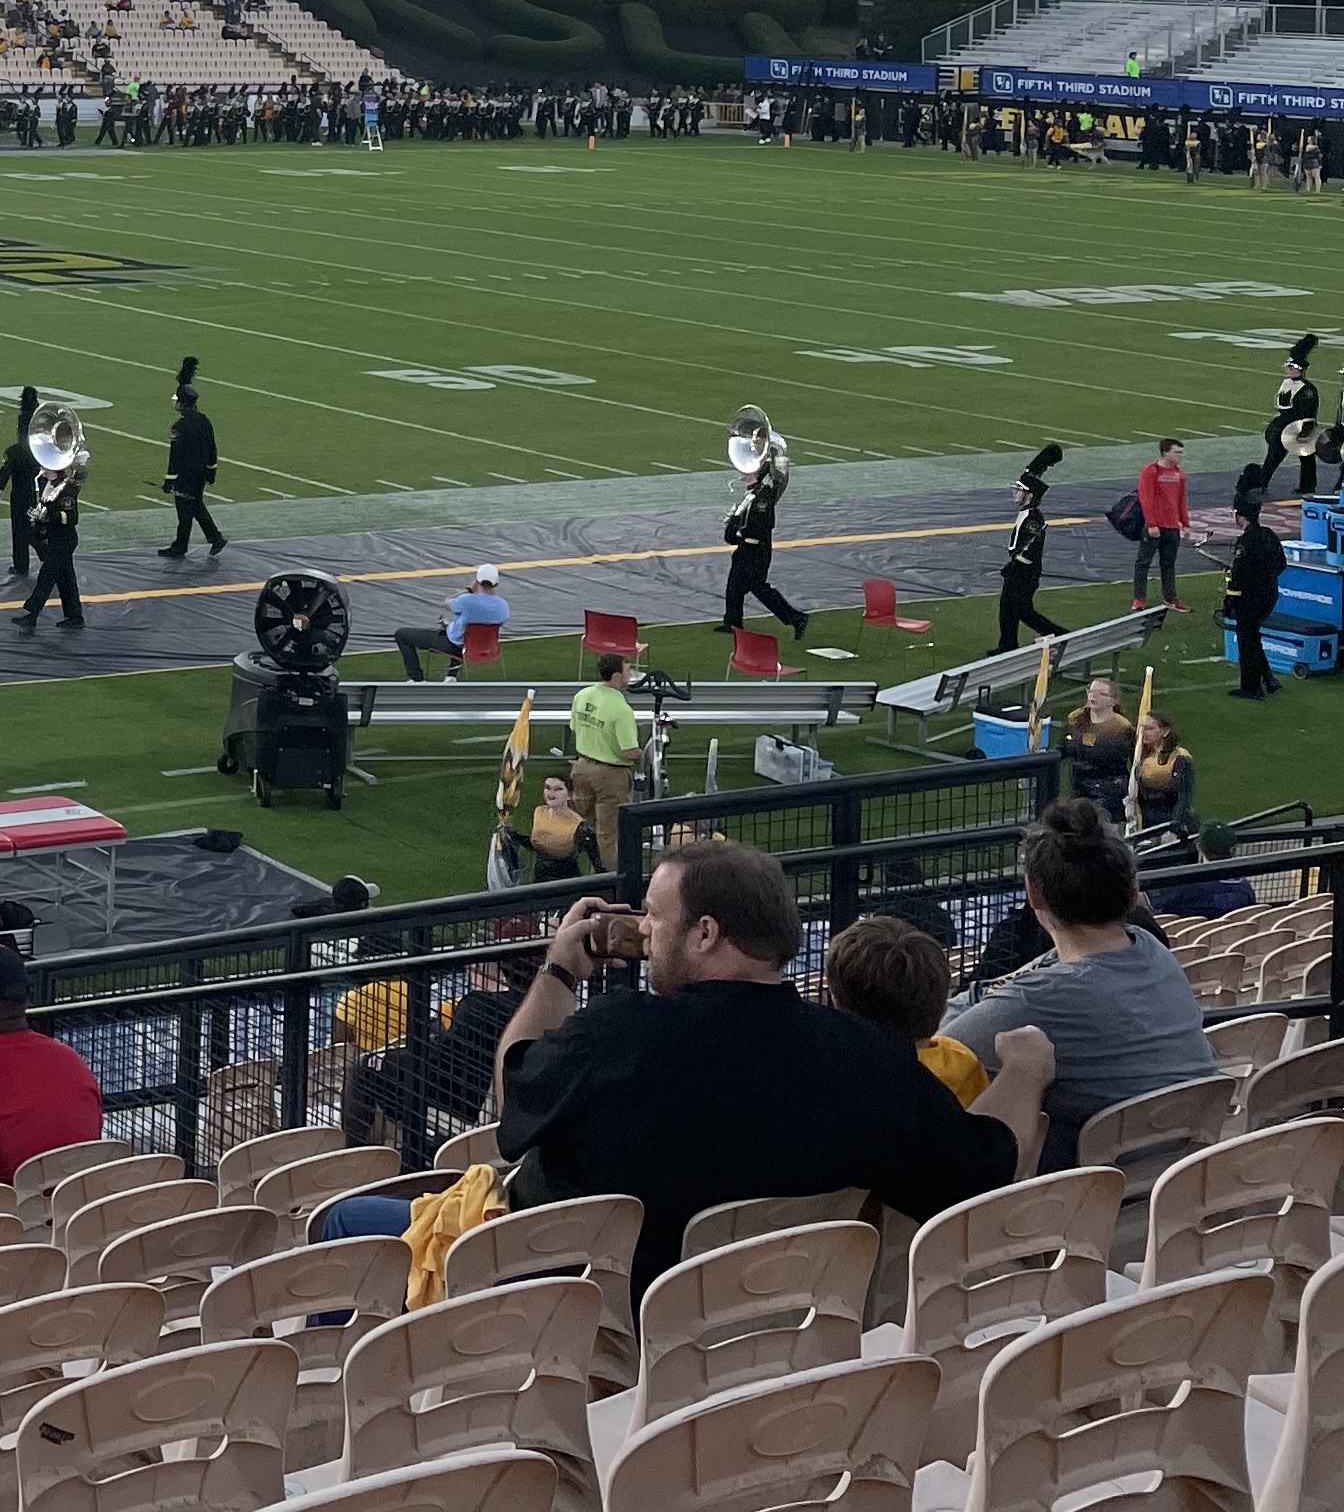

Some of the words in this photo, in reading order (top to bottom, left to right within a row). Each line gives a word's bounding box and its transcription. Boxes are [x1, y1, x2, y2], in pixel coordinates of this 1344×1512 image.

[825, 67, 859, 79] THIRD
[862, 69, 908, 81] STADIUM
[1017, 79, 1053, 92] FIFTH
[1057, 81, 1095, 93] THIRD
[1098, 84, 1152, 97] STADIUM
[1238, 92, 1278, 106] FIFTH
[1282, 94, 1326, 109] THIRD
